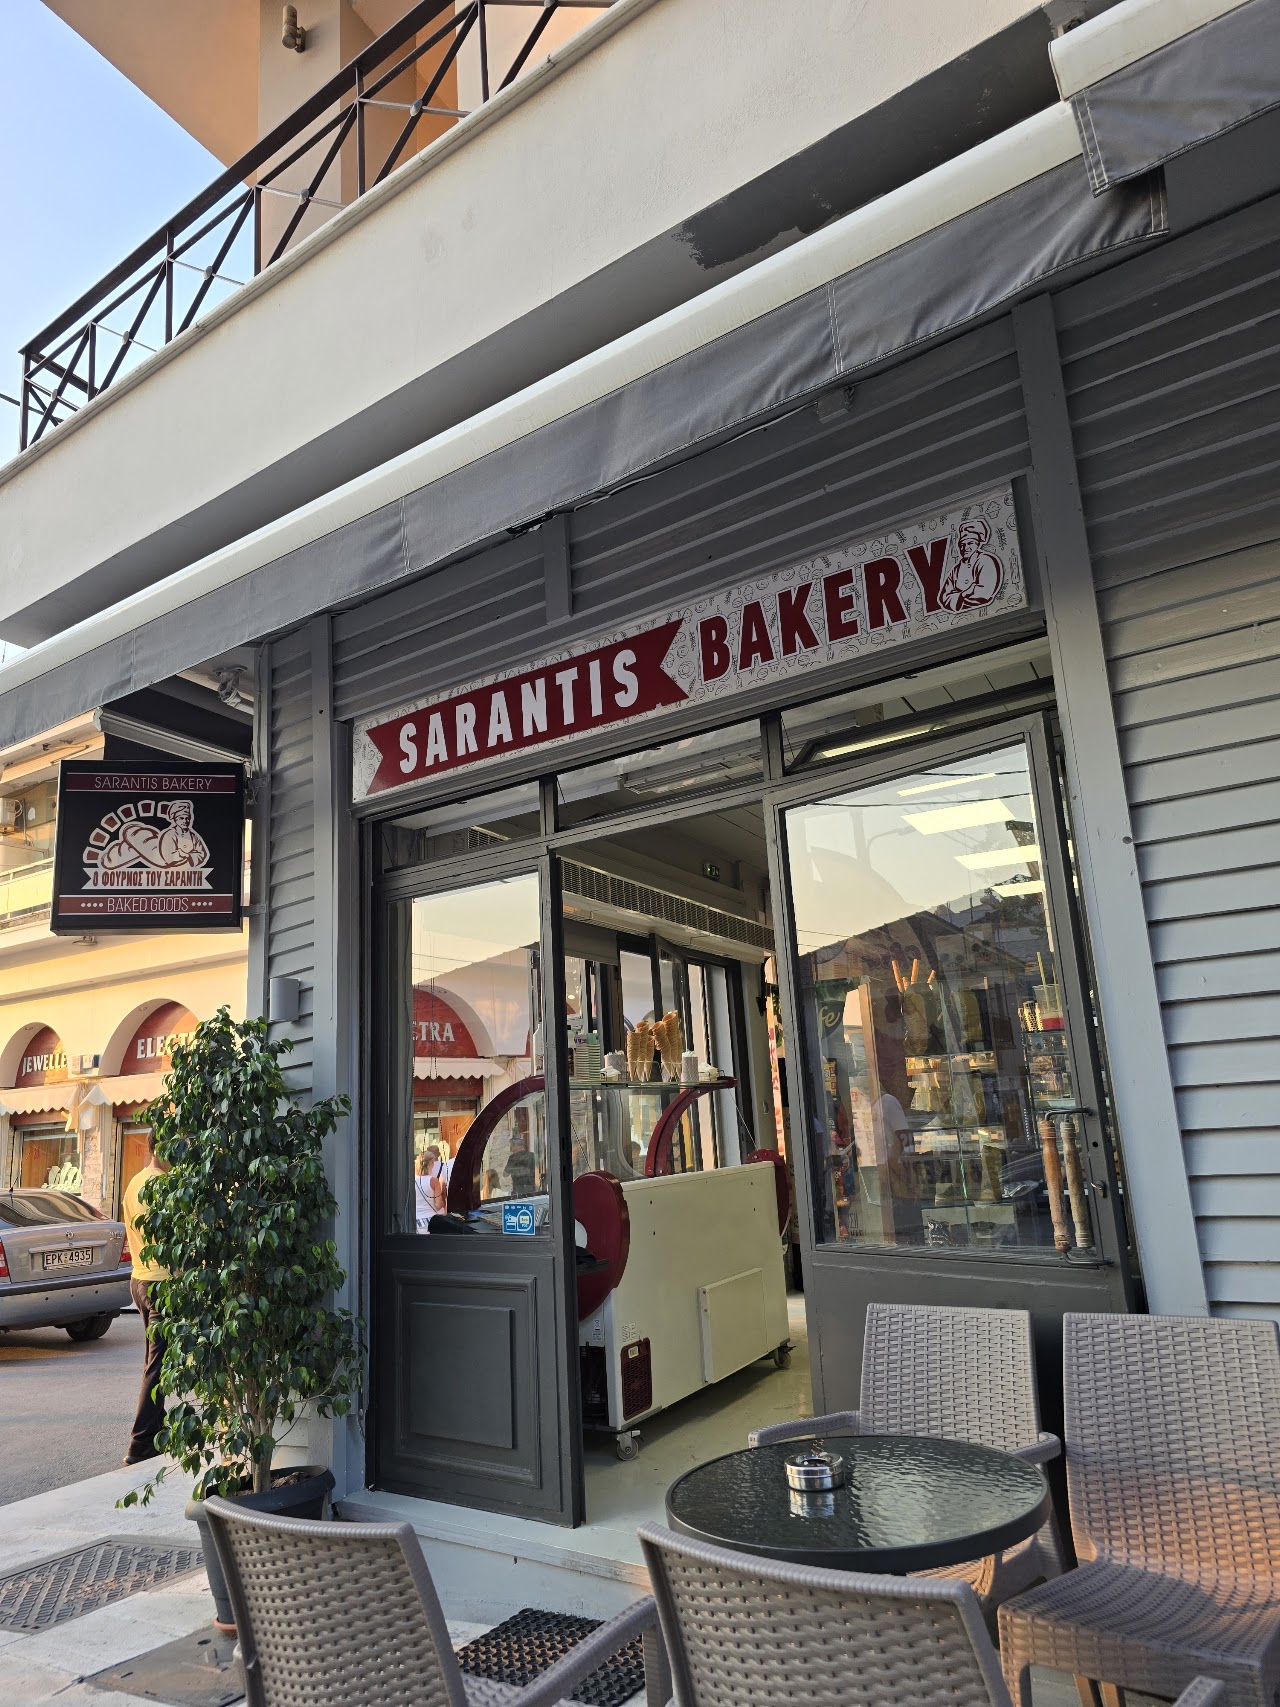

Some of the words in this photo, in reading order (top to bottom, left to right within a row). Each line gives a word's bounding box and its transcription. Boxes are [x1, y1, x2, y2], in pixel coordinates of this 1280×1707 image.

[399, 650, 639, 773] SARANTIS
[700, 535, 950, 681] BAKERY
[94, 776, 158, 790] SARANTIS
[162, 777, 212, 790] BAKERY
[101, 870, 143, 887] ΦΟΥΡΝΟΣ
[145, 870, 162, 887] ΤΟΥ
[164, 870, 203, 887] ΣΑΡΑΝΤΗ
[107, 897, 147, 912] BAKED
[150, 897, 189, 912] GOODS
